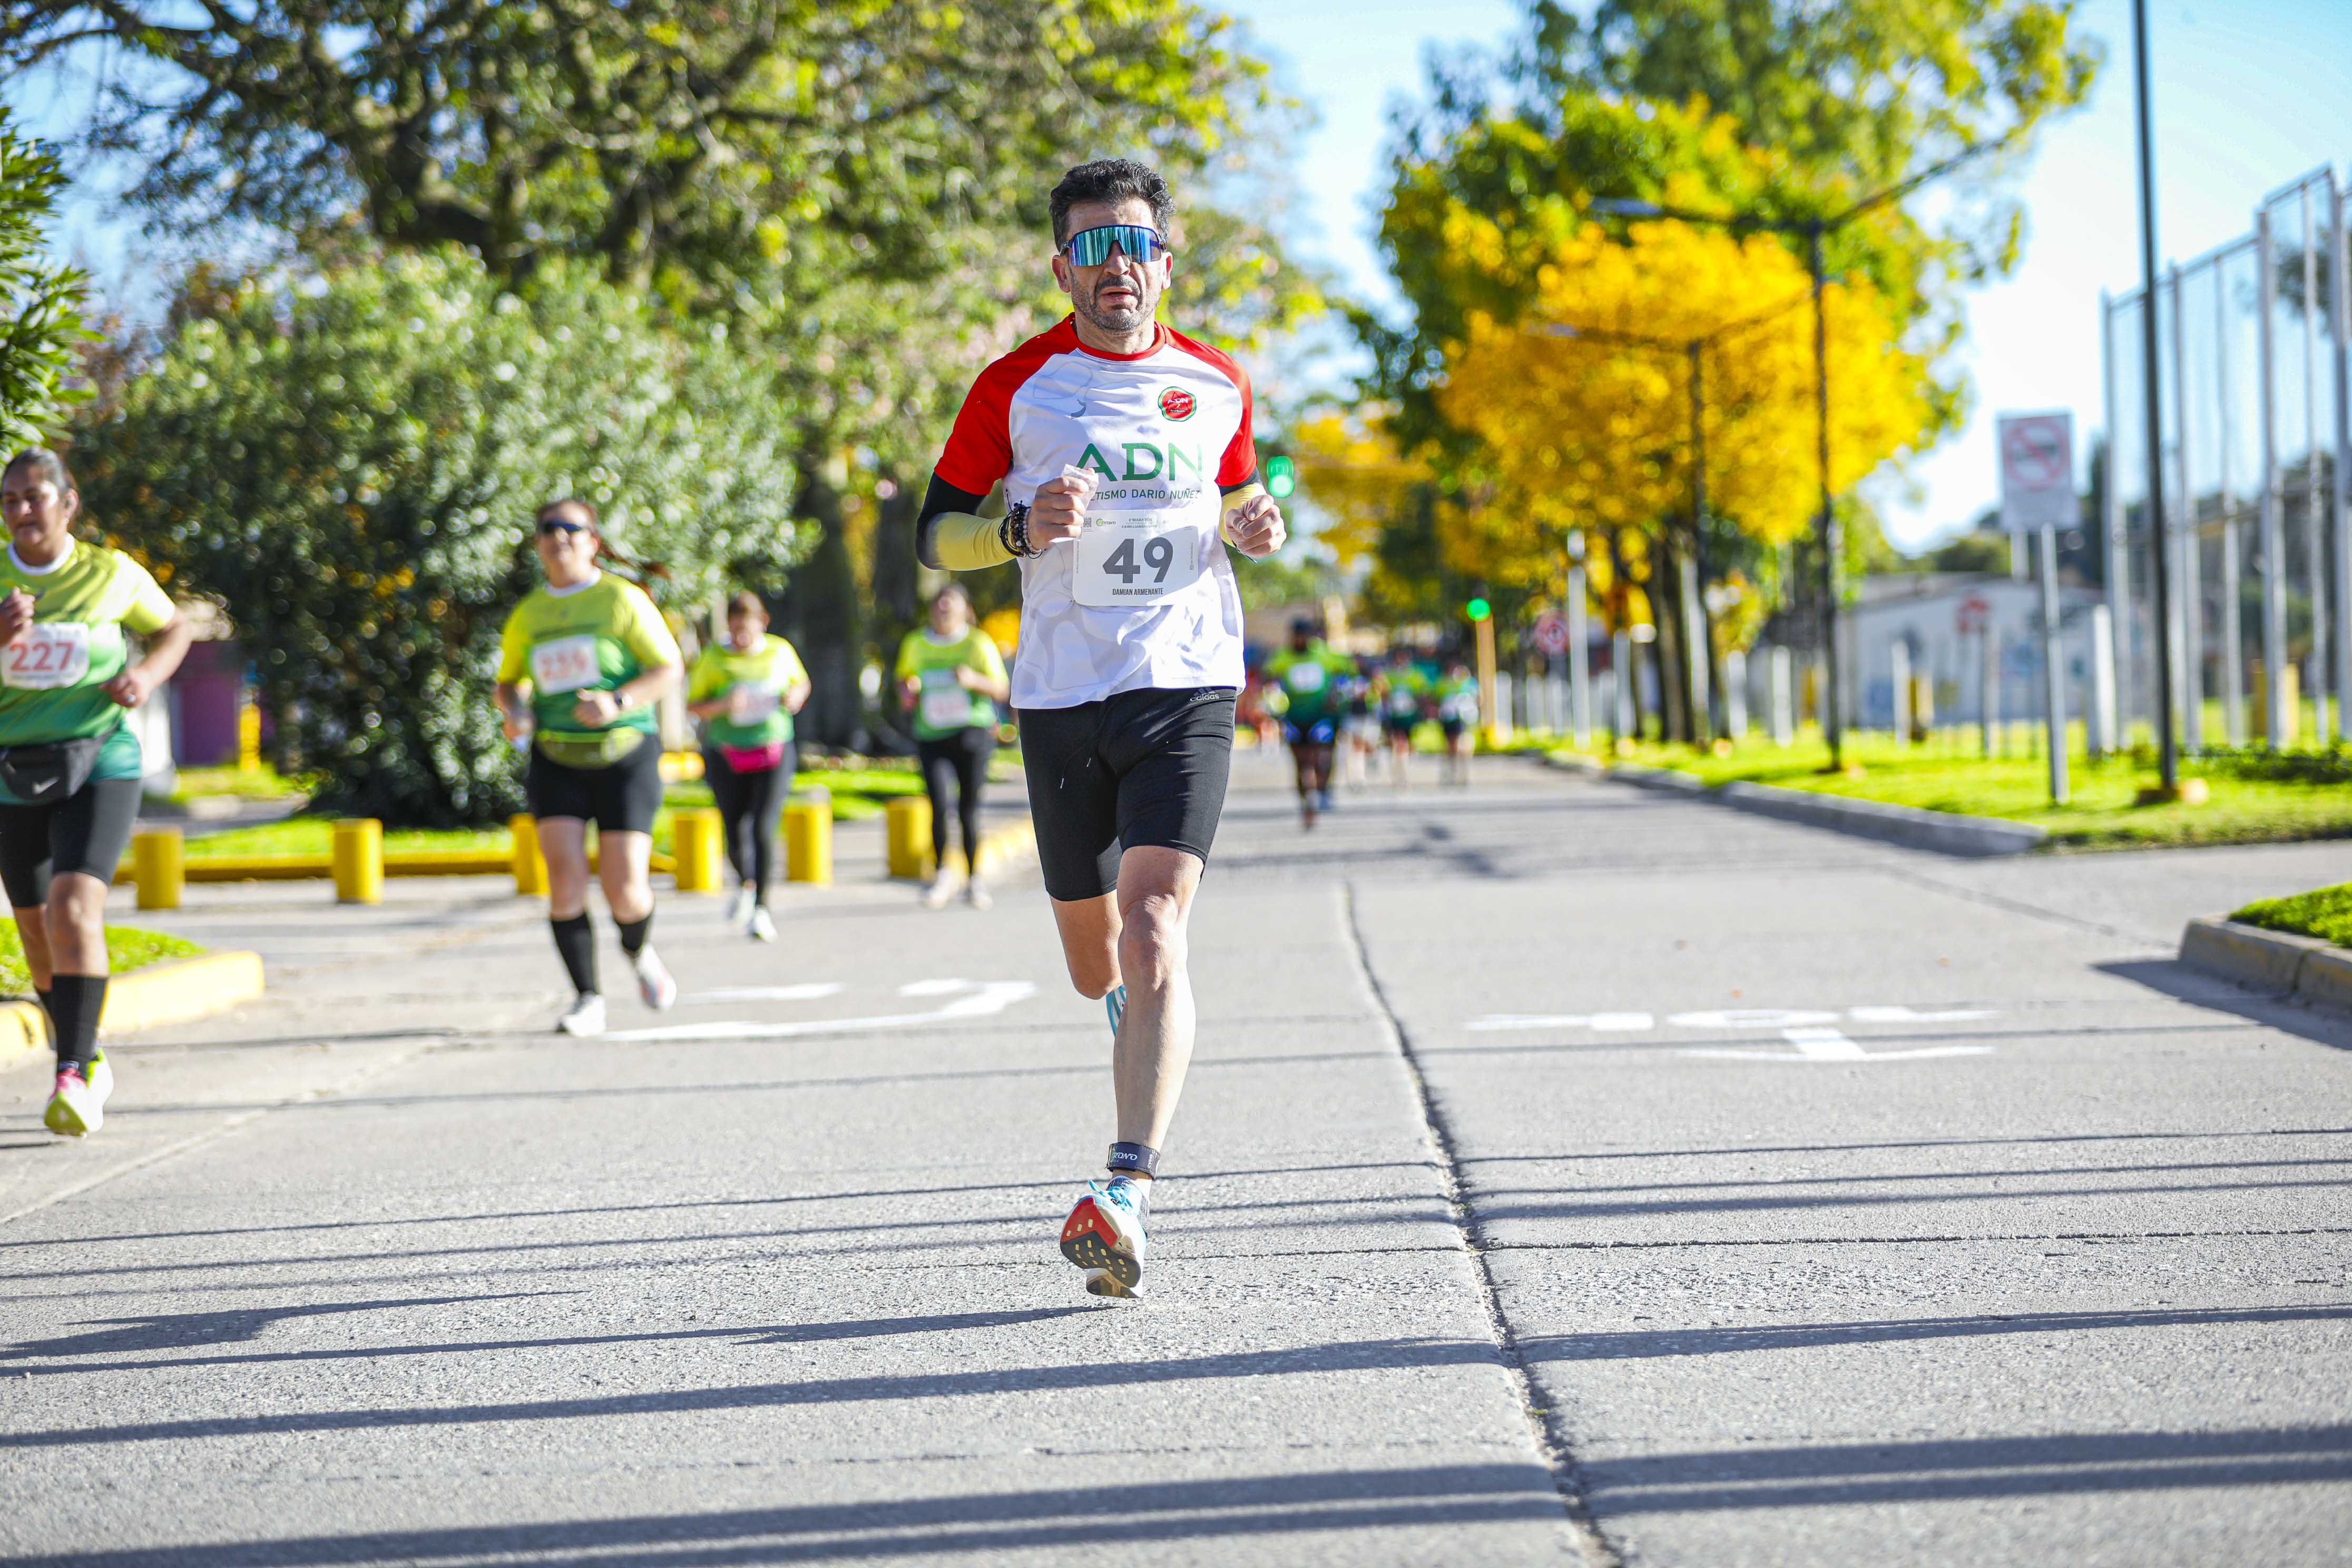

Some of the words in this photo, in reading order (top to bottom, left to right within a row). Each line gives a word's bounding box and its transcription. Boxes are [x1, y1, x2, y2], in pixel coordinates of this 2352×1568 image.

[1076, 443, 1203, 482] ADN
[1091, 489, 1127, 501] TISMO
[1132, 489, 1165, 499] DARIO
[1170, 488, 1201, 499] NUÑEZ
[1102, 537, 1173, 583] 49
[9, 641, 76, 672] 227
